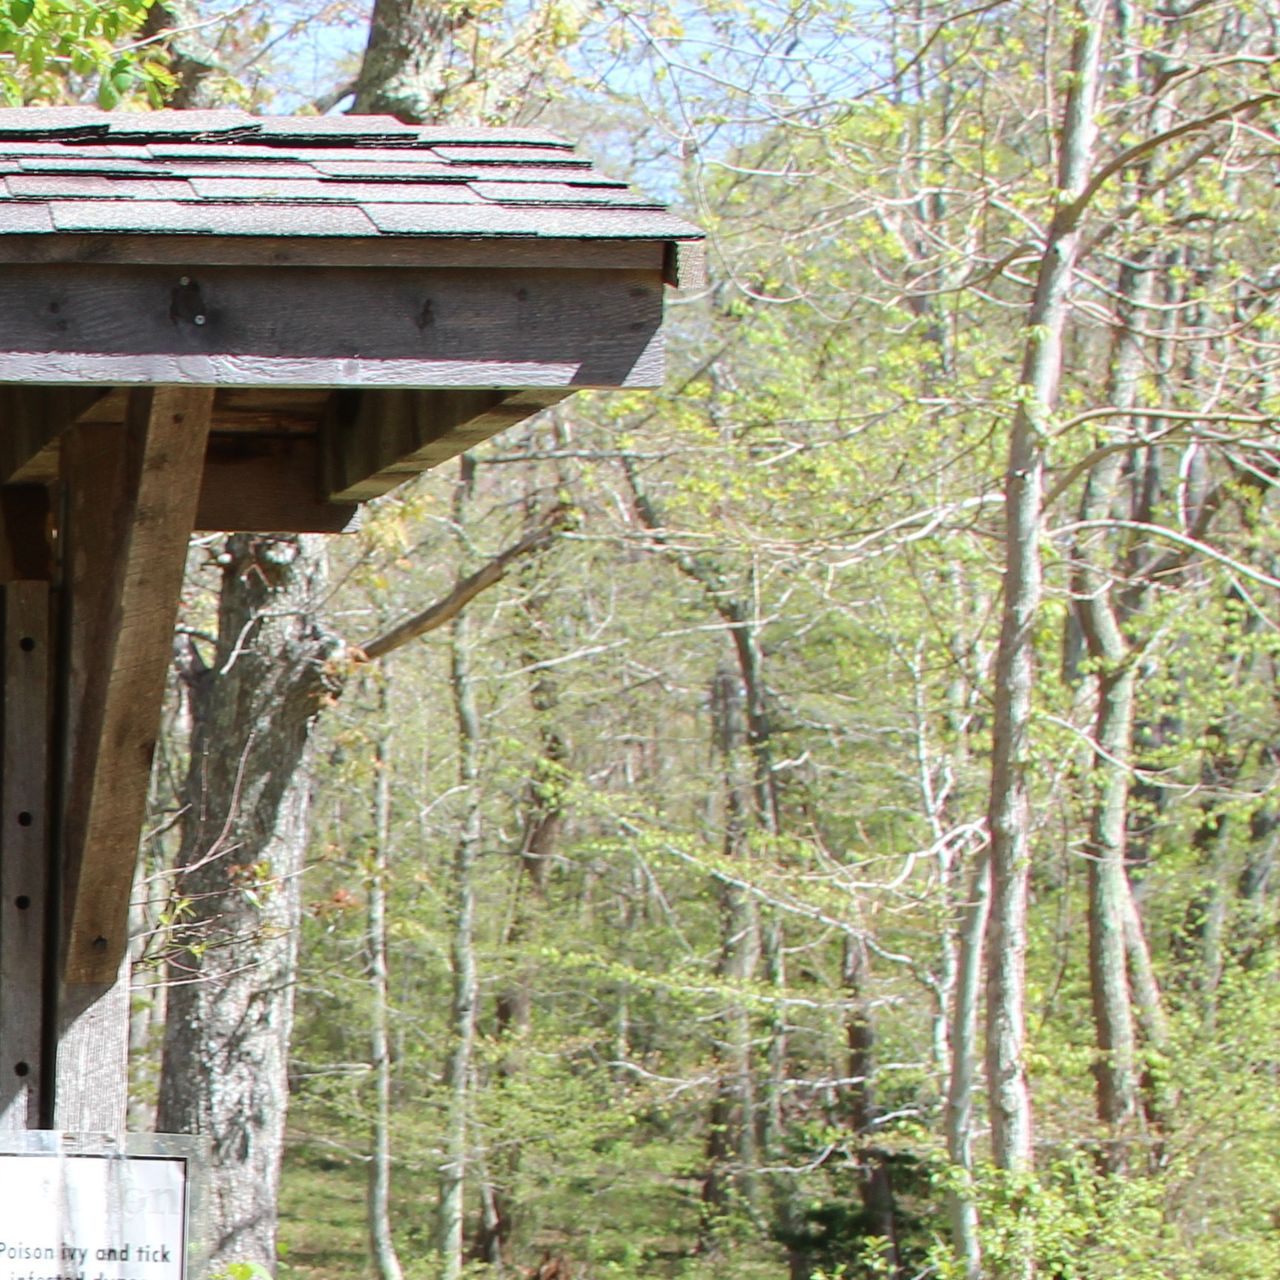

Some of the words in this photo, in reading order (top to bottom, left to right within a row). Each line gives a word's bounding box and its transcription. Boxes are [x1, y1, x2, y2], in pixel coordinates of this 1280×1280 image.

[60, 1242, 87, 1266] ivy
[96, 1243, 129, 1261] and
[137, 1244, 171, 1263] tick
